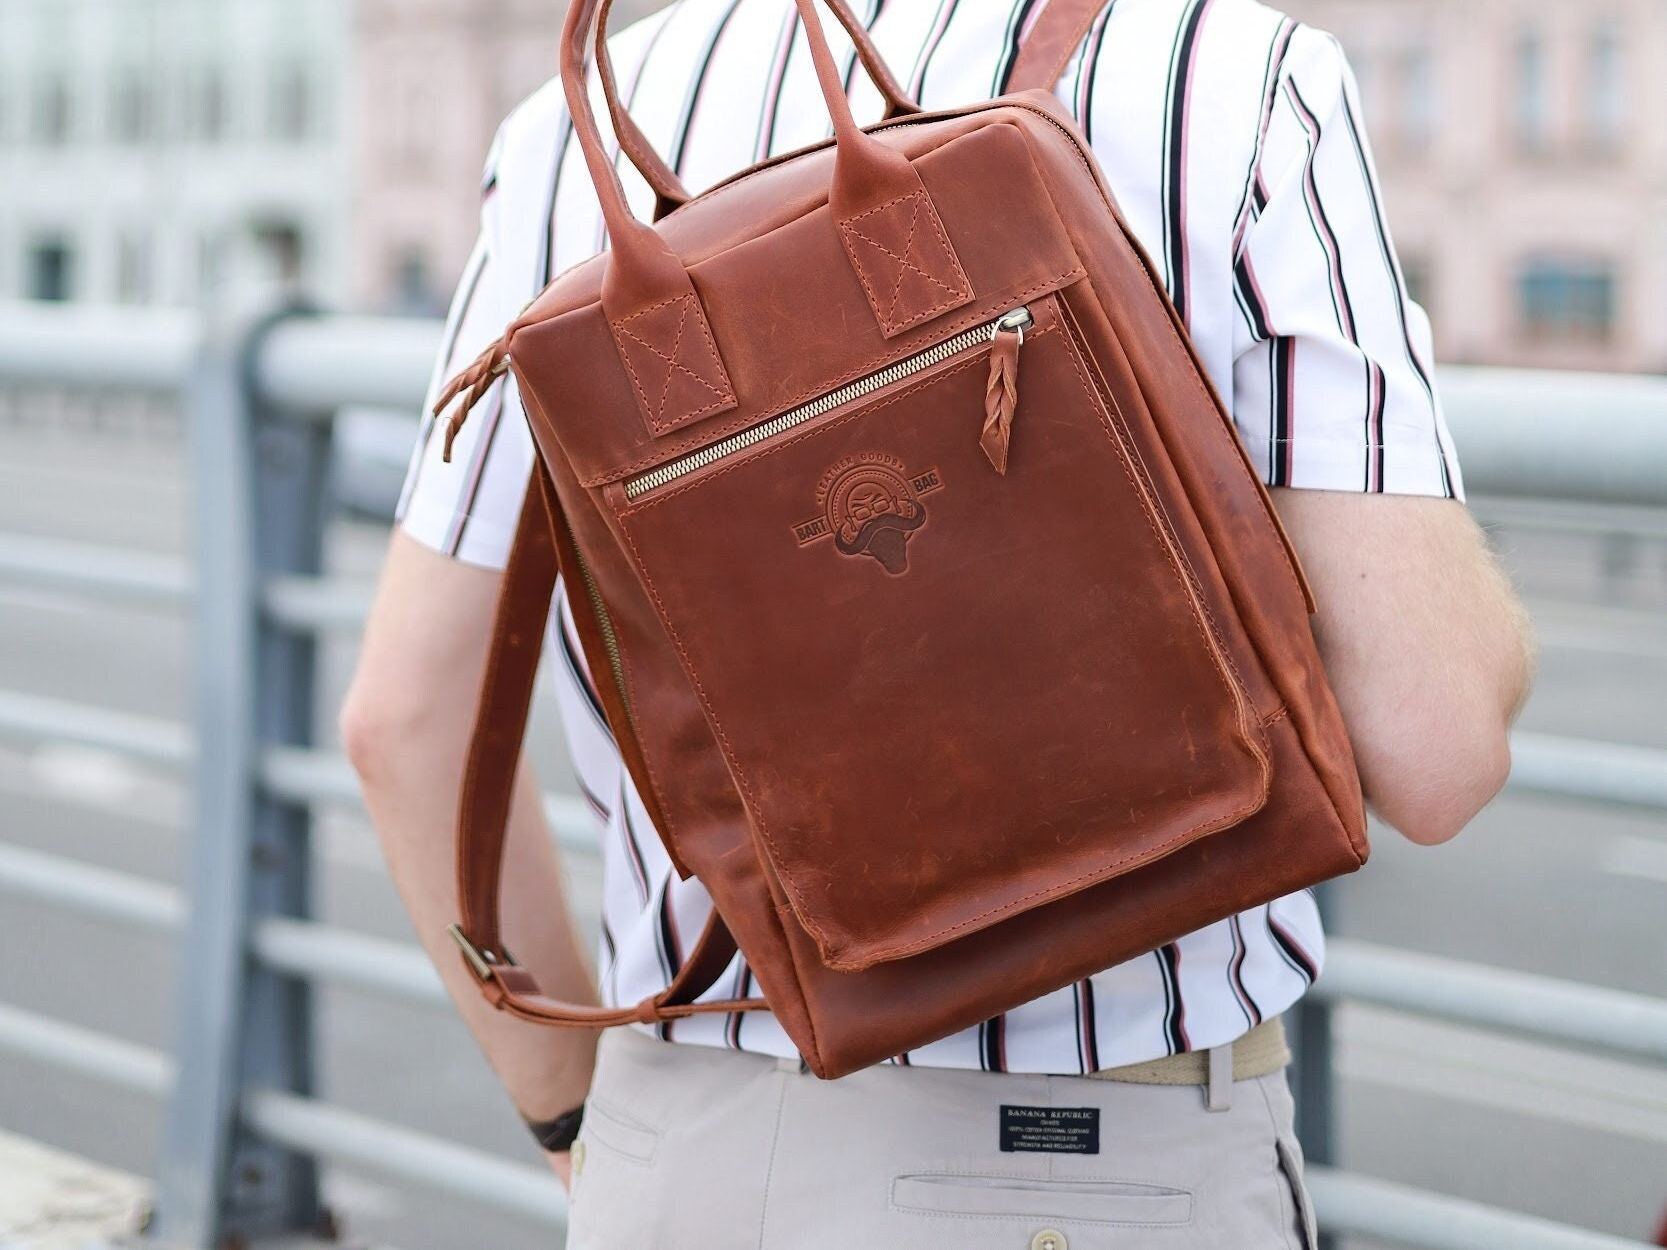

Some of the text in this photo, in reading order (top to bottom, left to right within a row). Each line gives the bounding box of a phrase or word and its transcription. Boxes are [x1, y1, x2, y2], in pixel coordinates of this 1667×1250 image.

[817, 453, 898, 496] LEATHER GOODS
[796, 473, 939, 541] BART BAG
[1007, 1109, 1093, 1119] BANANA REPUBLIC
